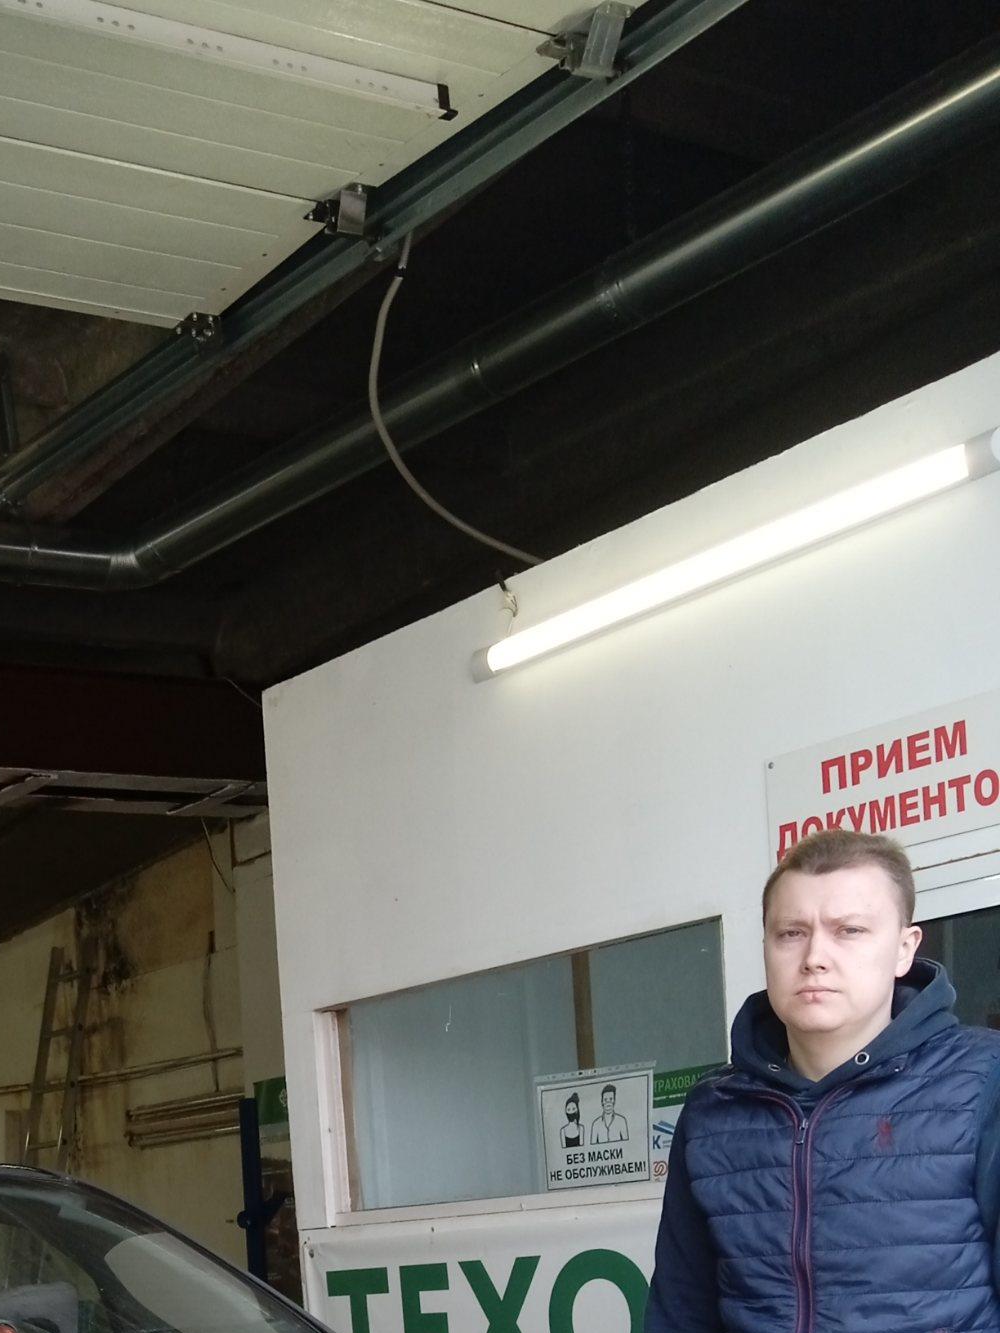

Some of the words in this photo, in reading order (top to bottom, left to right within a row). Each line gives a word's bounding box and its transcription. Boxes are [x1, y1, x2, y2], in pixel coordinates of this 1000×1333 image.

[821, 719, 968, 795] ПРИЕМ
[566, 1152, 586, 1165] БЕЗ
[588, 1148, 624, 1162] МАСКИ
[549, 1169, 563, 1182] НЕ
[565, 1161, 647, 1180] ОБСЛУЖИВАЕМ!
